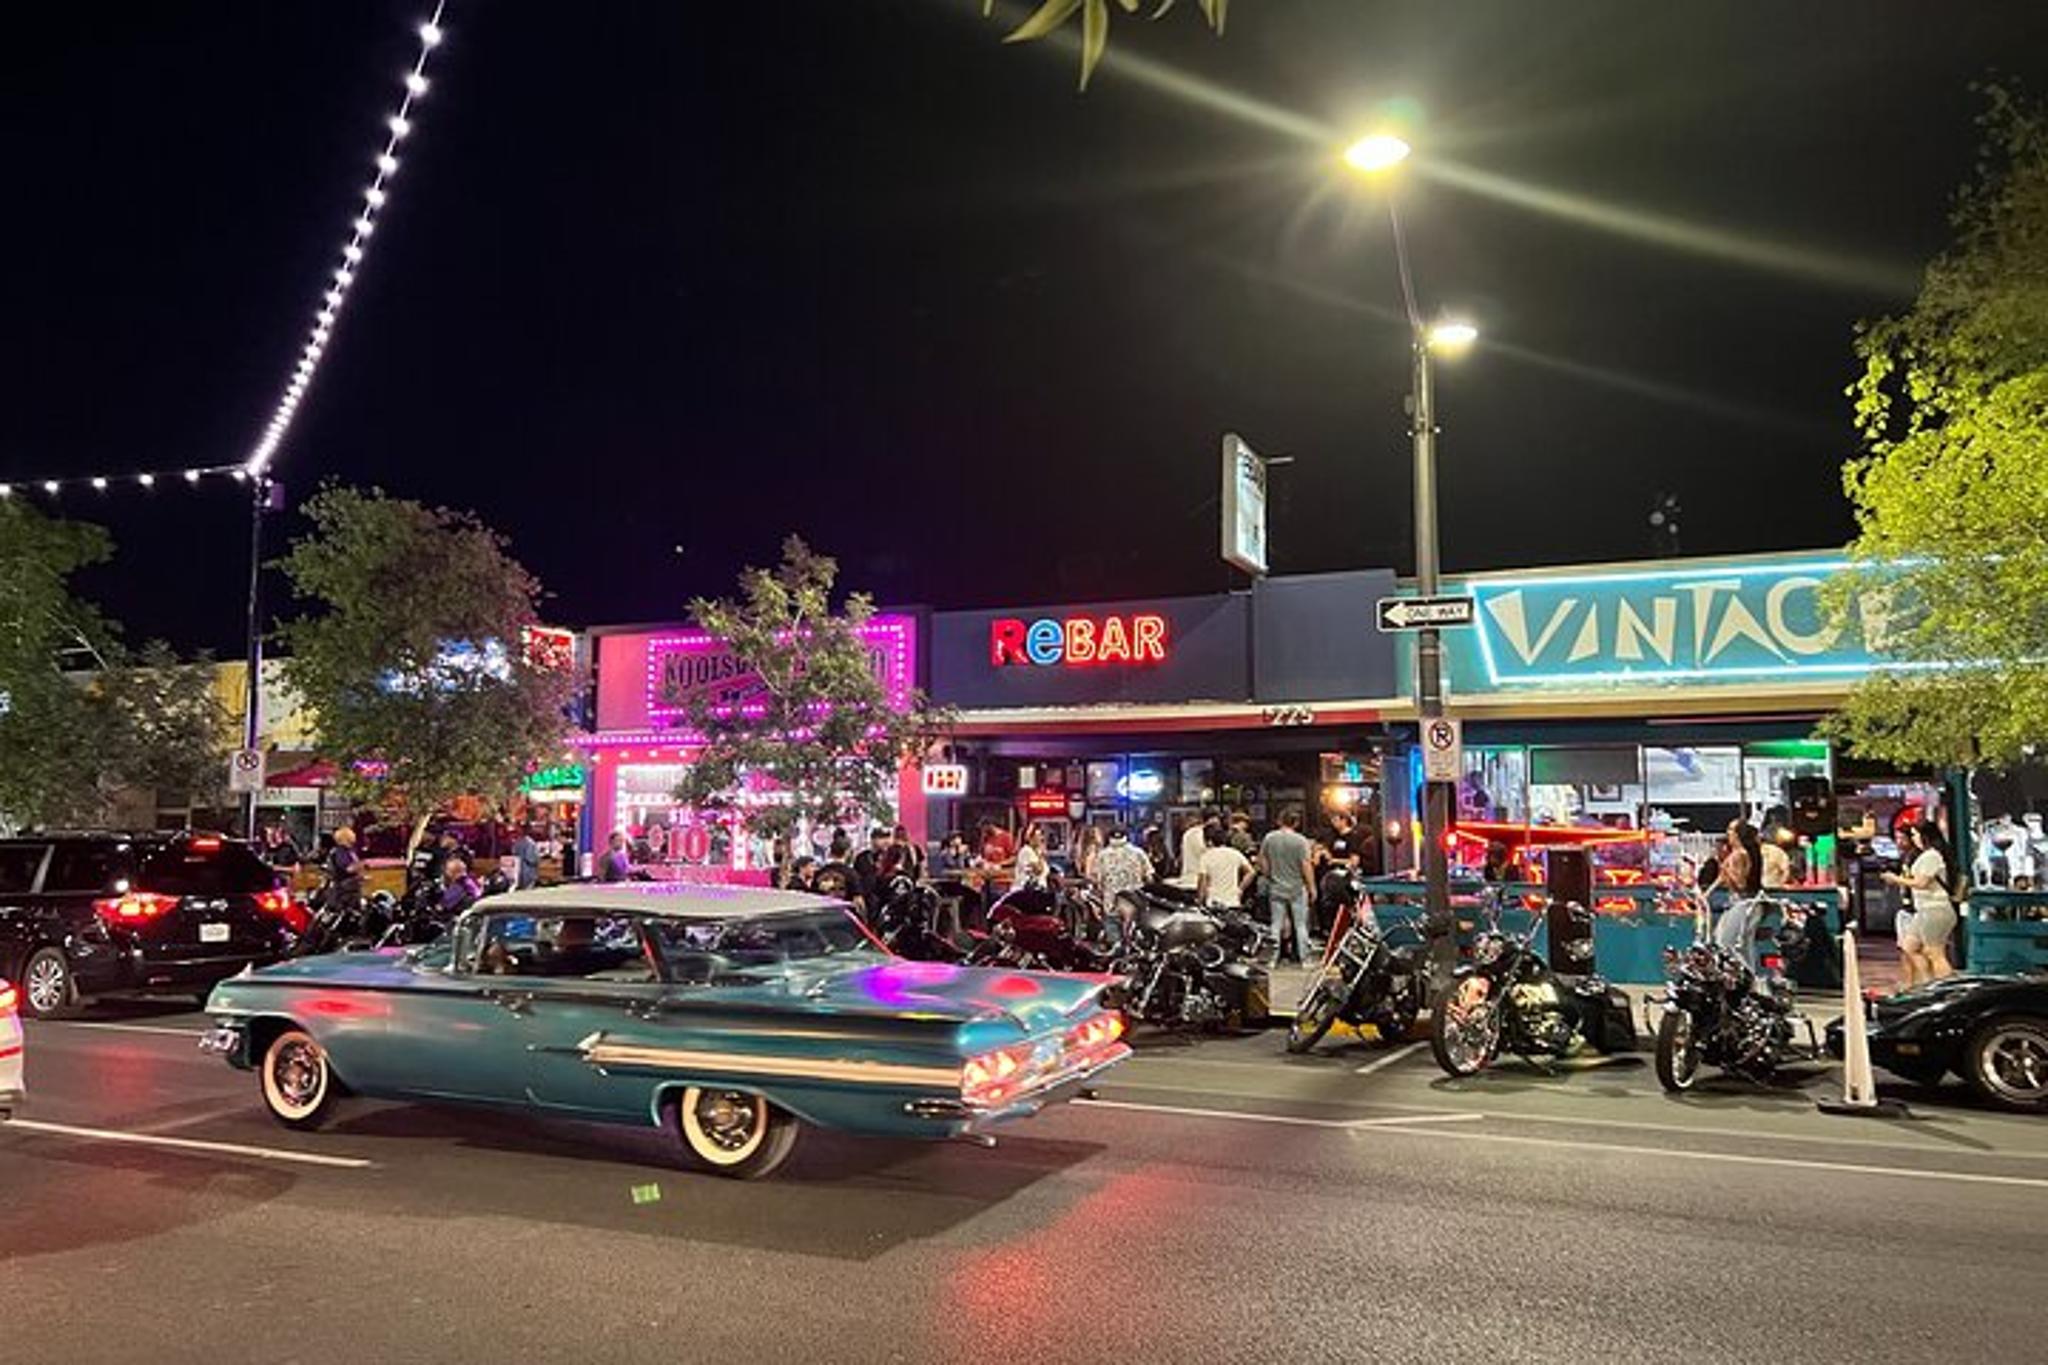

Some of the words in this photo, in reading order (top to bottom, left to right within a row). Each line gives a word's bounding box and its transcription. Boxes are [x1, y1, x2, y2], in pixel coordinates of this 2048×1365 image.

[1407, 607, 1432, 621] ONE
[1438, 607, 1464, 620] WAY
[991, 616, 1165, 666] ReBAR
